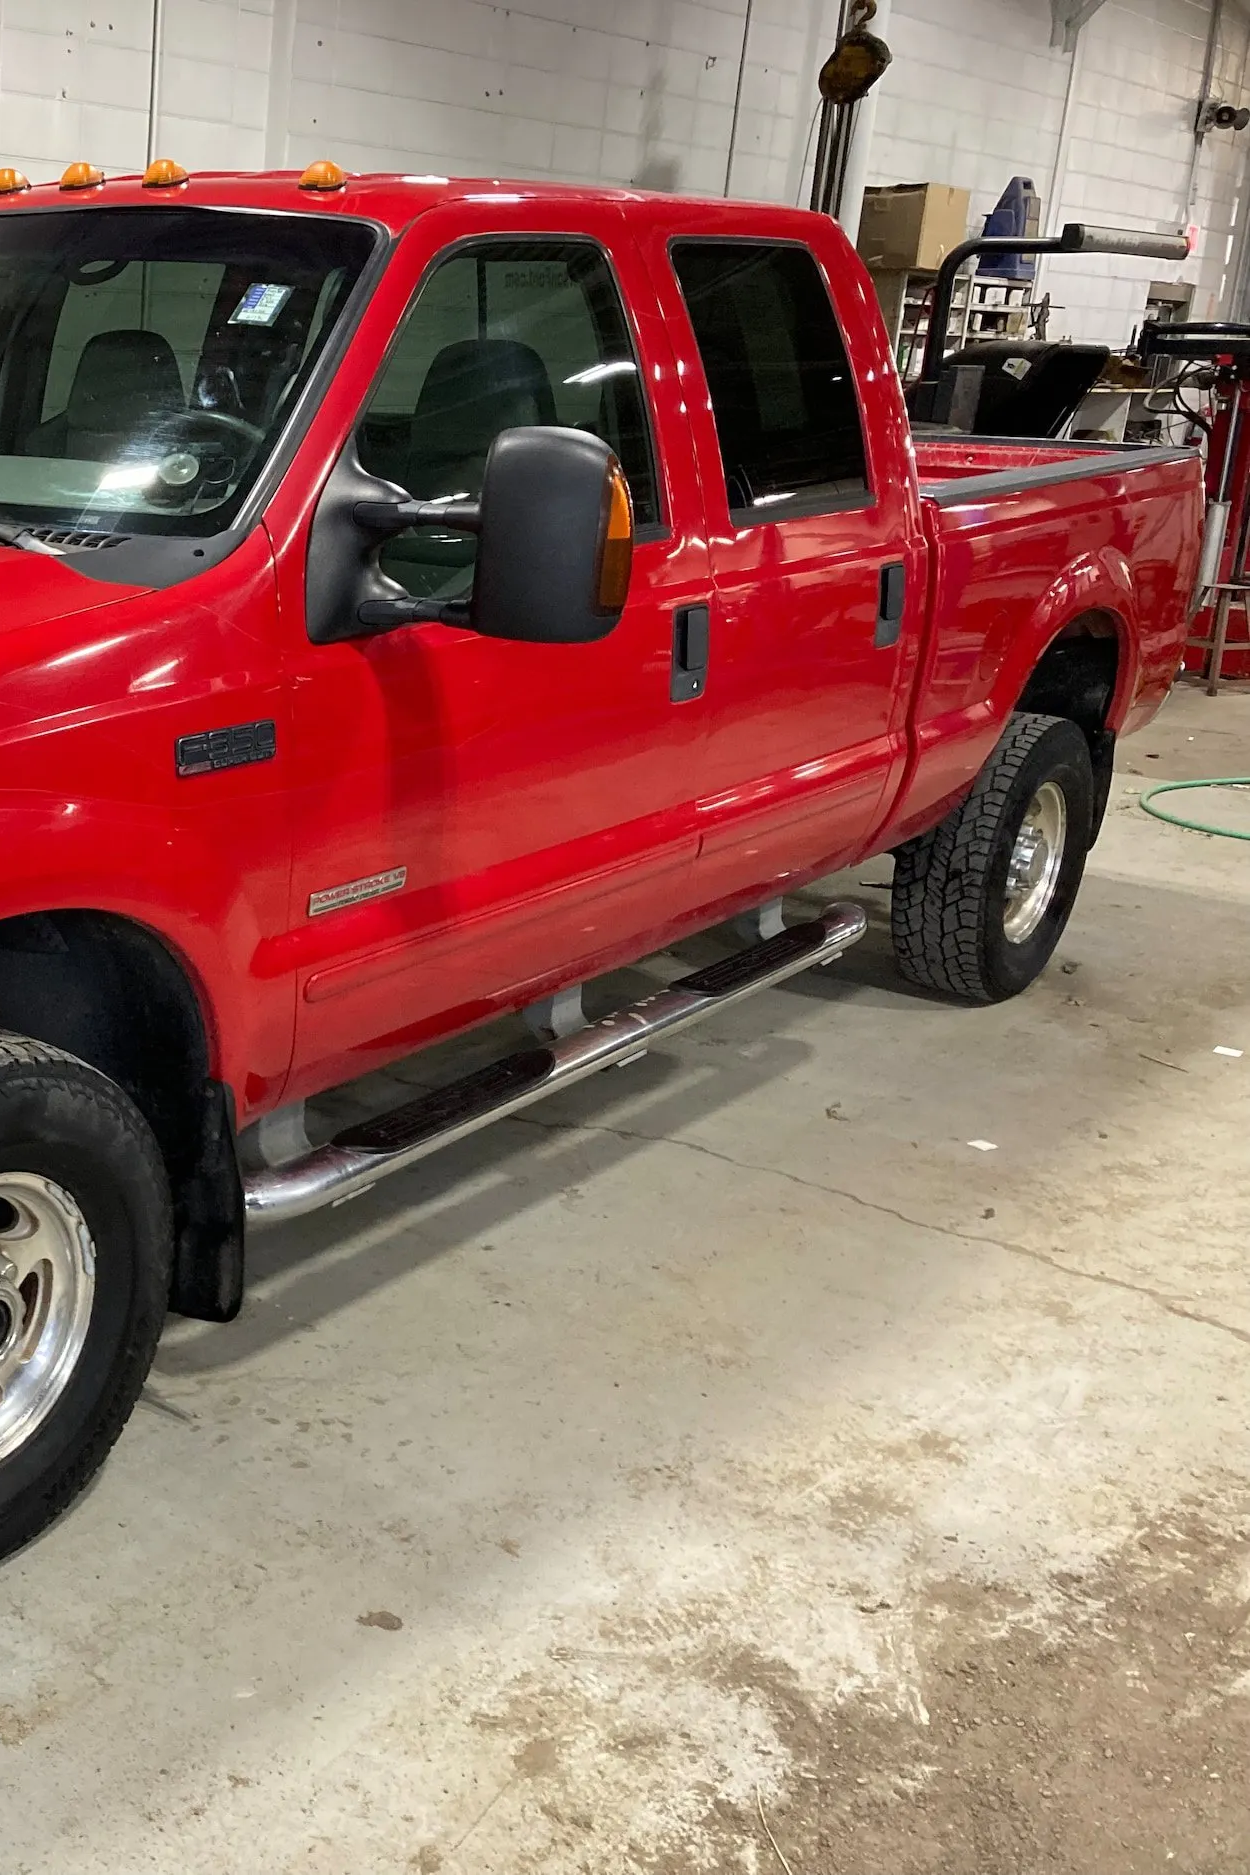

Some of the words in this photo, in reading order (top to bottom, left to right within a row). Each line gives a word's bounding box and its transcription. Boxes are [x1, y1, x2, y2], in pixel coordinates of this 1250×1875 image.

[312, 887, 350, 905] POWER
[352, 876, 391, 894] STROKE
[393, 870, 406, 880] V8
